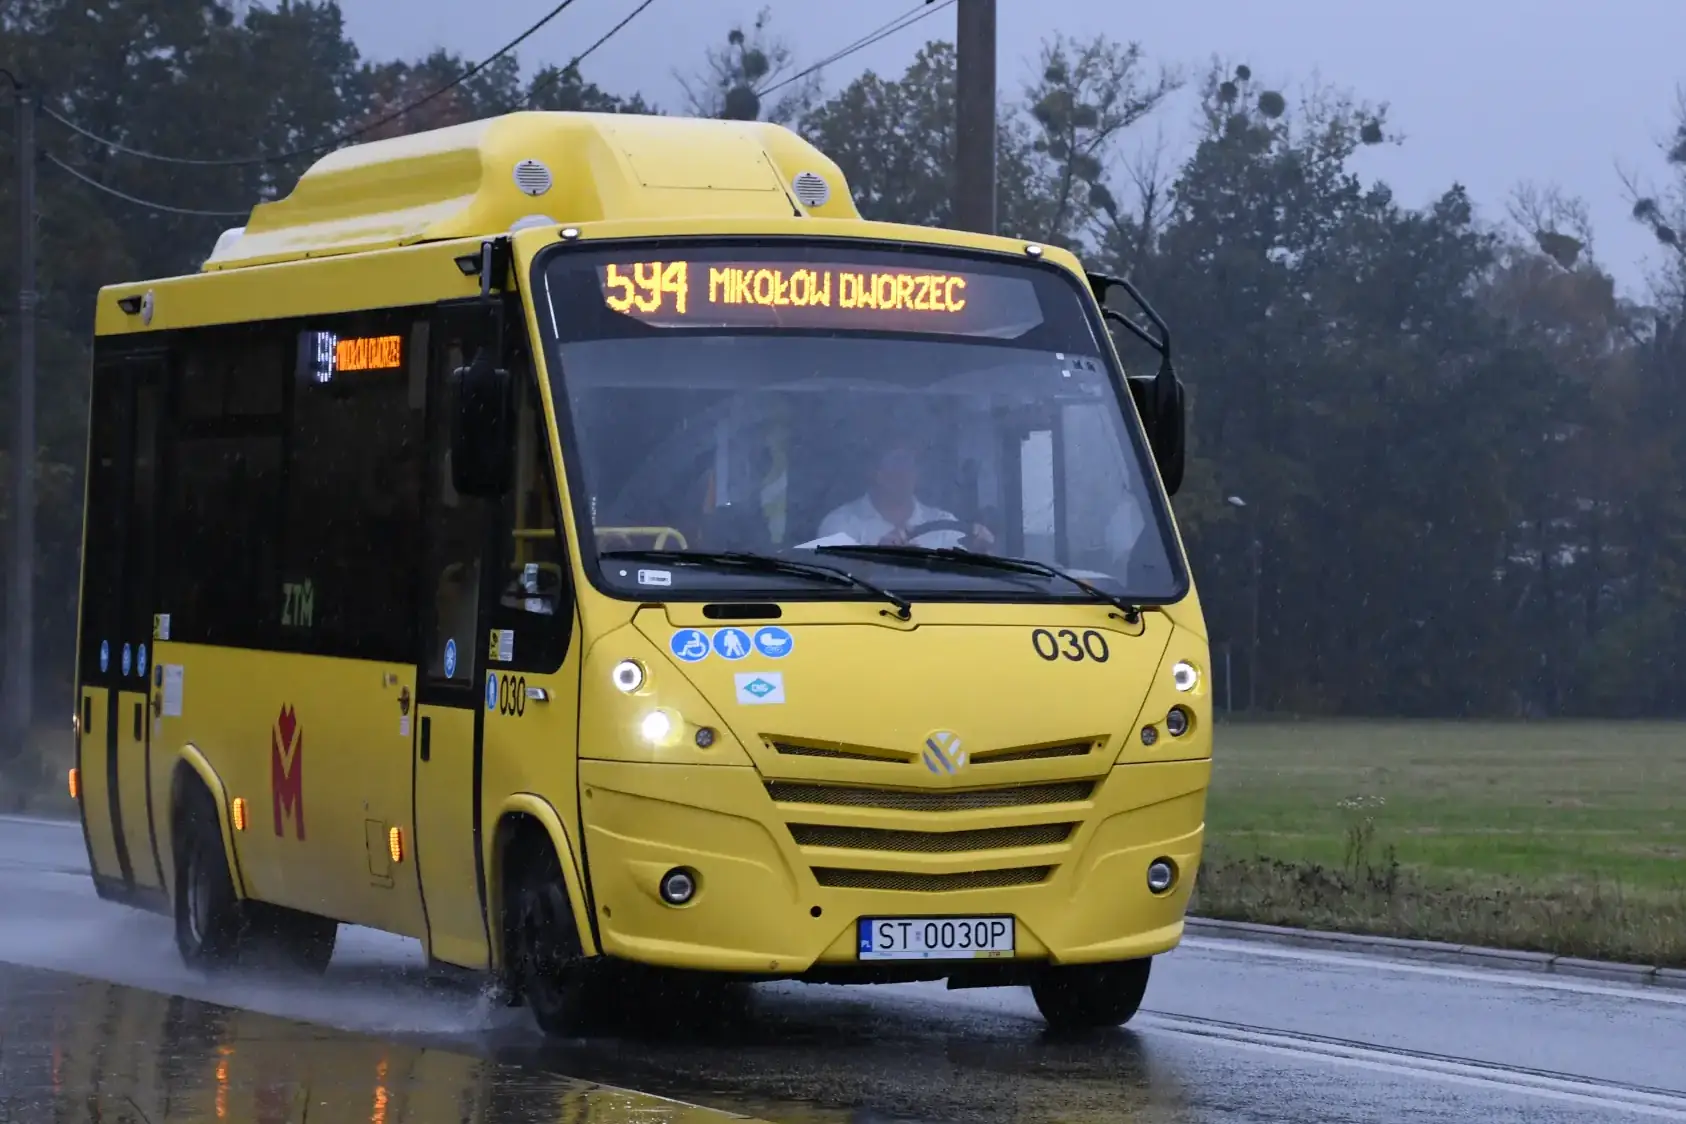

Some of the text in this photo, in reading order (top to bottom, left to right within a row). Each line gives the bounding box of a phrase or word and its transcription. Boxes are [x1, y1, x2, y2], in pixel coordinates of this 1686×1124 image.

[606, 261, 966, 314] 594 MIKOŁÓW DWORZEC
[281, 577, 314, 628] ZTM
[1031, 628, 1109, 663] 030
[500, 675, 526, 717] 030
[879, 921, 1006, 949] ST 0030P
